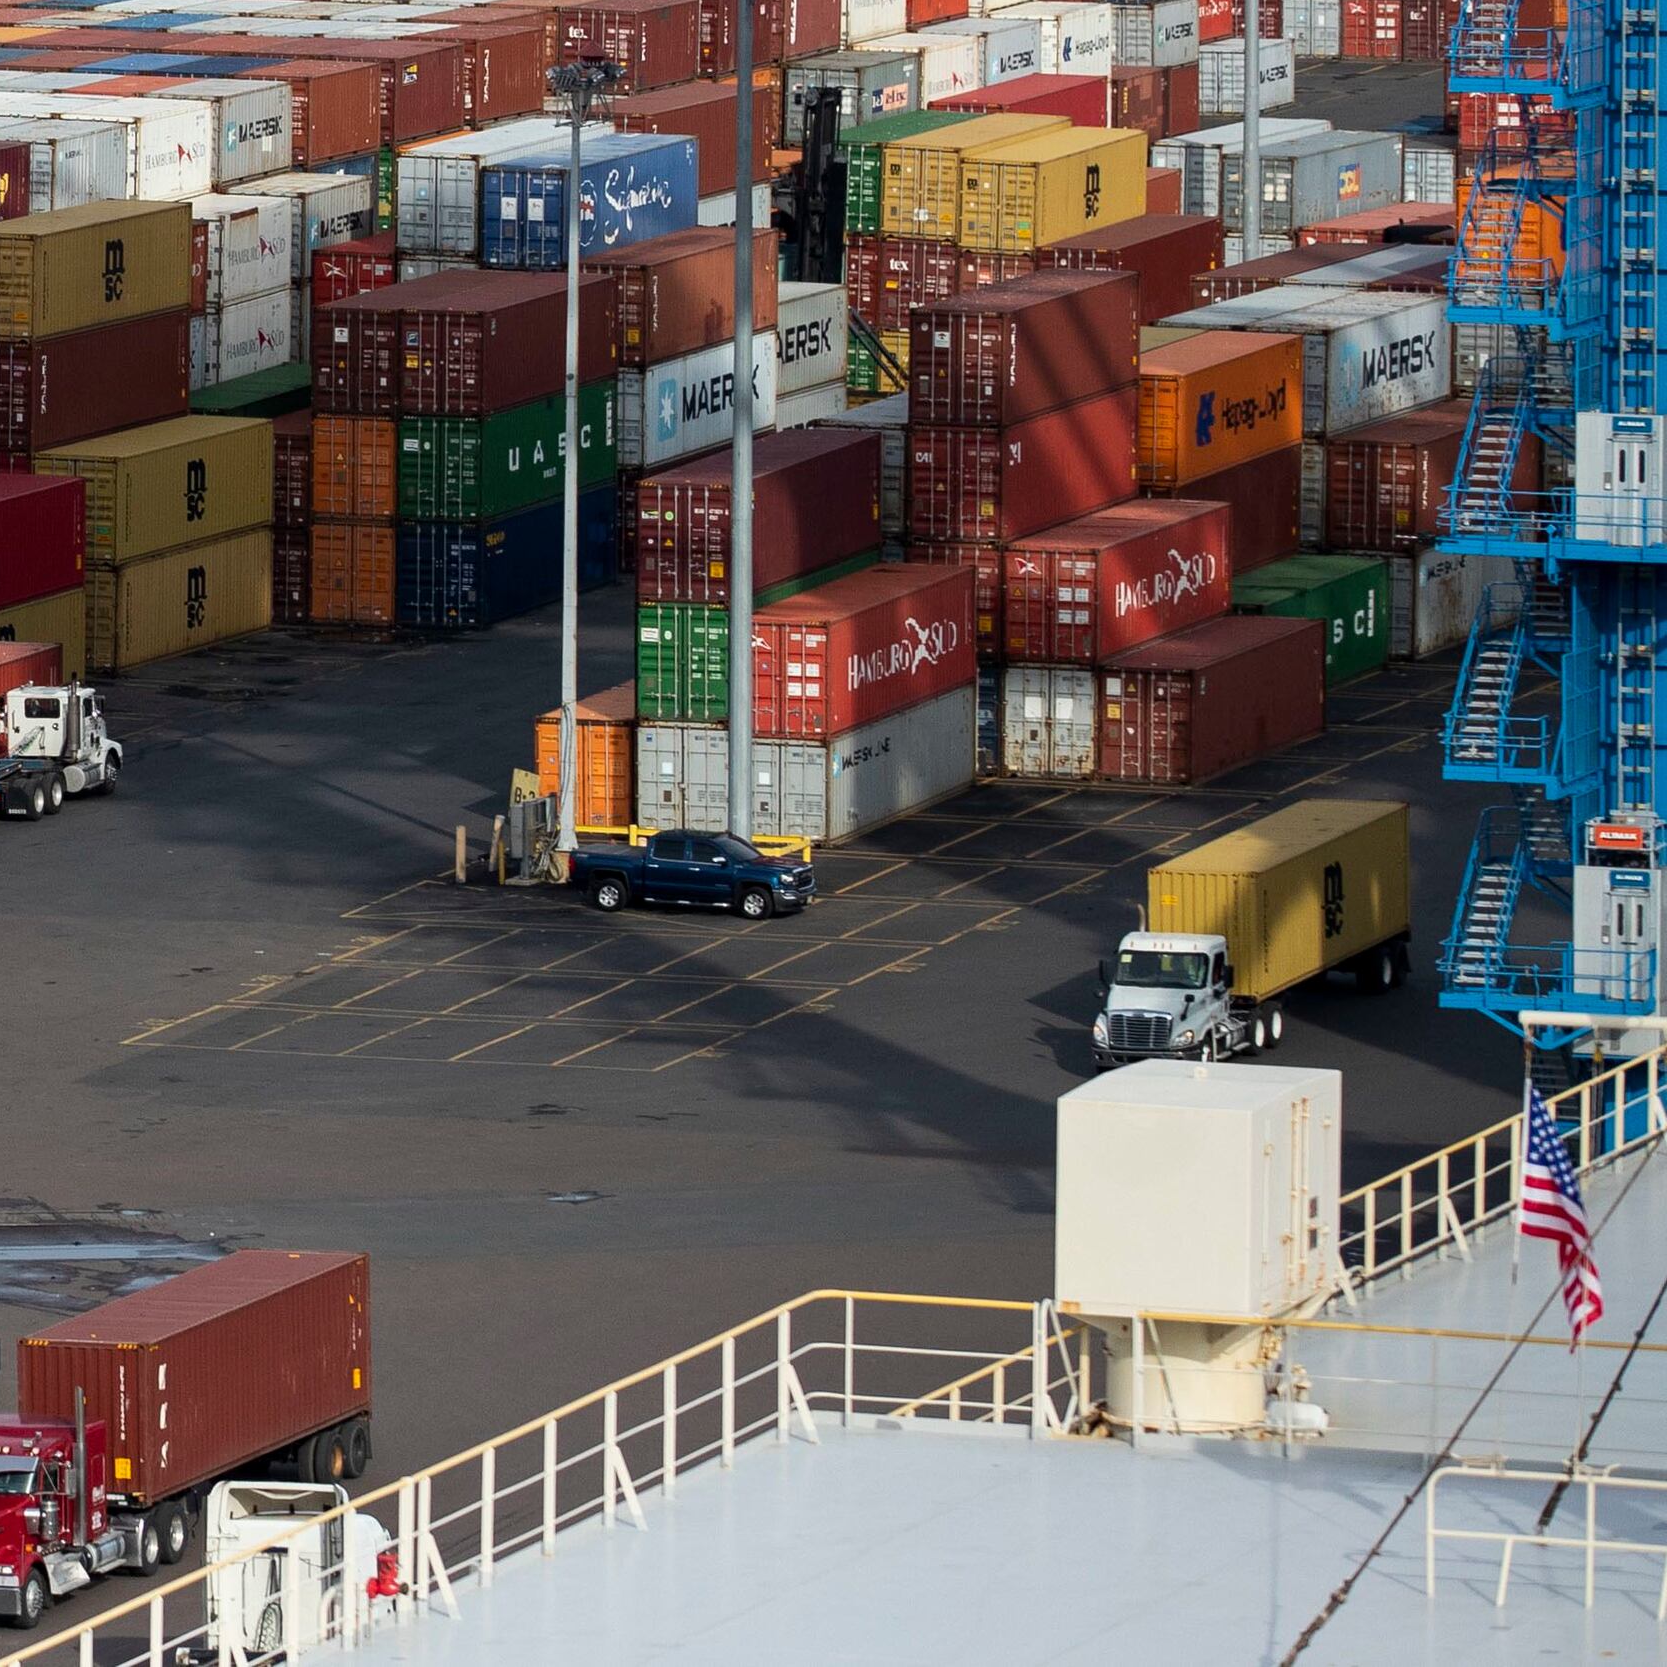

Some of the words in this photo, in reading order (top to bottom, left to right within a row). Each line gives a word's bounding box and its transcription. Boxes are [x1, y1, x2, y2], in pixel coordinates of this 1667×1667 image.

[239, 115, 282, 142] MAERSK
[889, 258, 908, 271] tex
[1363, 331, 1436, 385] MAERSK
[681, 364, 760, 423] MAERK
[1115, 570, 1172, 619] HAMBURG
[848, 633, 911, 687] HAMBURG
